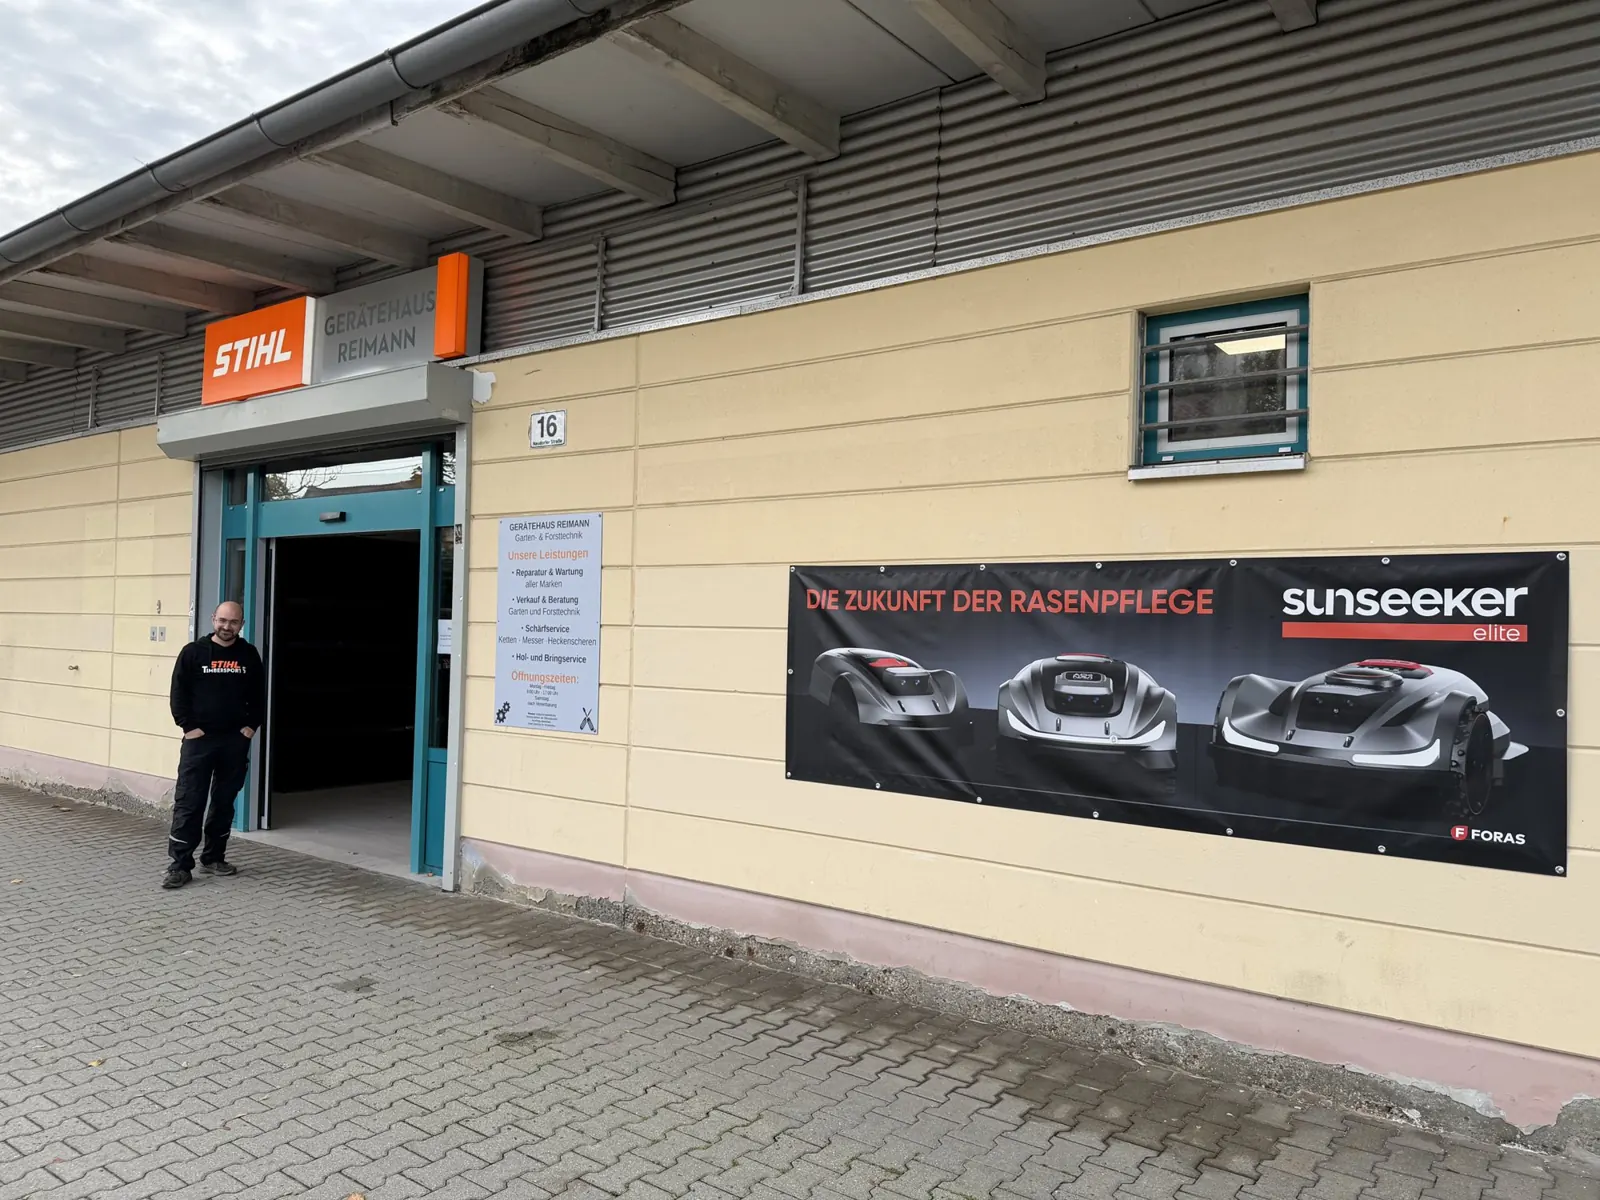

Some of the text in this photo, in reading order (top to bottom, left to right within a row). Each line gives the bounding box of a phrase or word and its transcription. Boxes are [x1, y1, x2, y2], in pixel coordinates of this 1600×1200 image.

[324, 289, 436, 336] GERÄTEHAUS
[338, 326, 416, 363] REIMANN
[212, 328, 292, 378] STIHL
[537, 414, 557, 438] 16
[509, 519, 590, 531] GERÄTEHAUS REIMANN
[515, 531, 583, 542] Garten- & Forsttechnik
[508, 549, 589, 561] Unsere Leistungen
[516, 567, 584, 578] Reparatur & Wartung
[525, 580, 562, 588] aller Marken
[516, 595, 579, 606] Verkauf & Beratung
[806, 589, 1214, 615] DIE ZUKUNFT DER RASENPFLEGE
[1282, 586, 1529, 617] sunseeker
[508, 607, 581, 616] Garten und Forsttechnik
[525, 624, 570, 633] Schärfservice
[1473, 623, 1520, 641] elite
[498, 636, 597, 646] Ketten Messer Heckenscheren
[211, 660, 241, 669] STIHL
[516, 653, 587, 664] Hol- und Bringservice
[1471, 829, 1526, 845] FORAS
